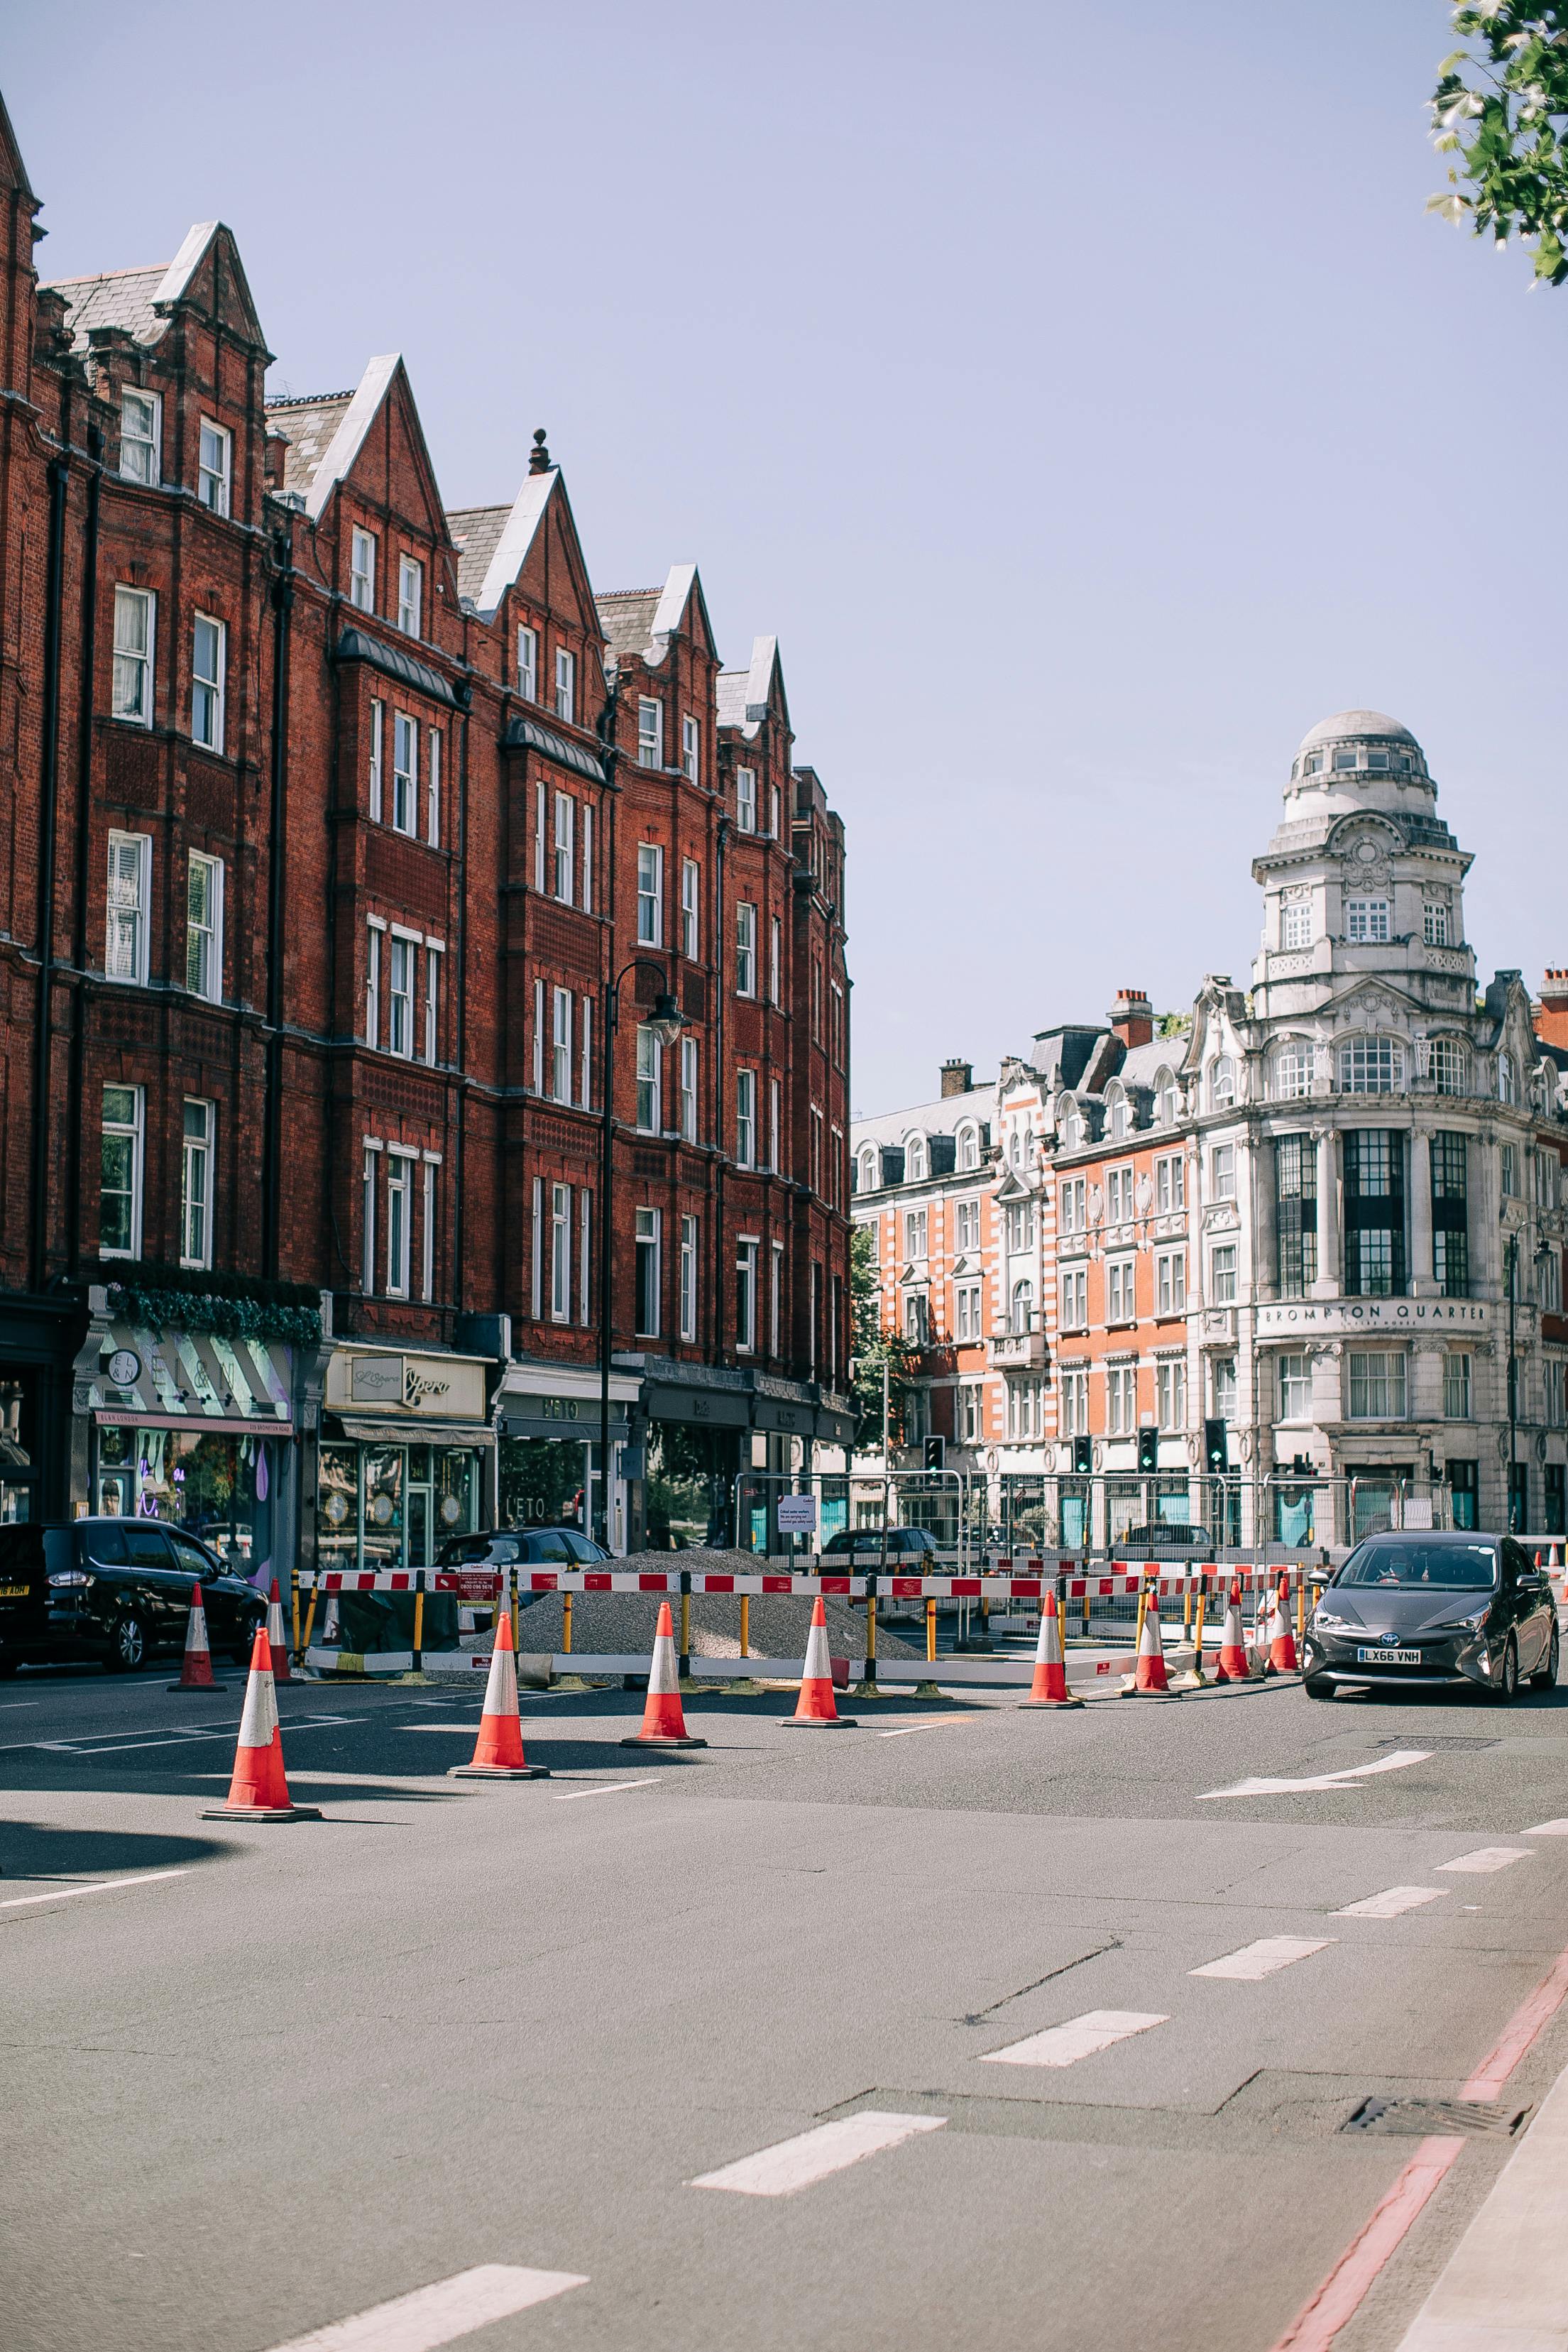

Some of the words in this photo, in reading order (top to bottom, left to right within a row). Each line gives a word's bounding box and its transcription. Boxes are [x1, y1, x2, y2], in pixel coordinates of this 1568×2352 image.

[1266, 1306, 1381, 1322] BROMPTON
[1396, 1305, 1484, 1320] QUARTER
[506, 1498, 544, 1518] L'ETO
[1365, 1650, 1394, 1661] LX66
[1397, 1651, 1419, 1662] VNH
